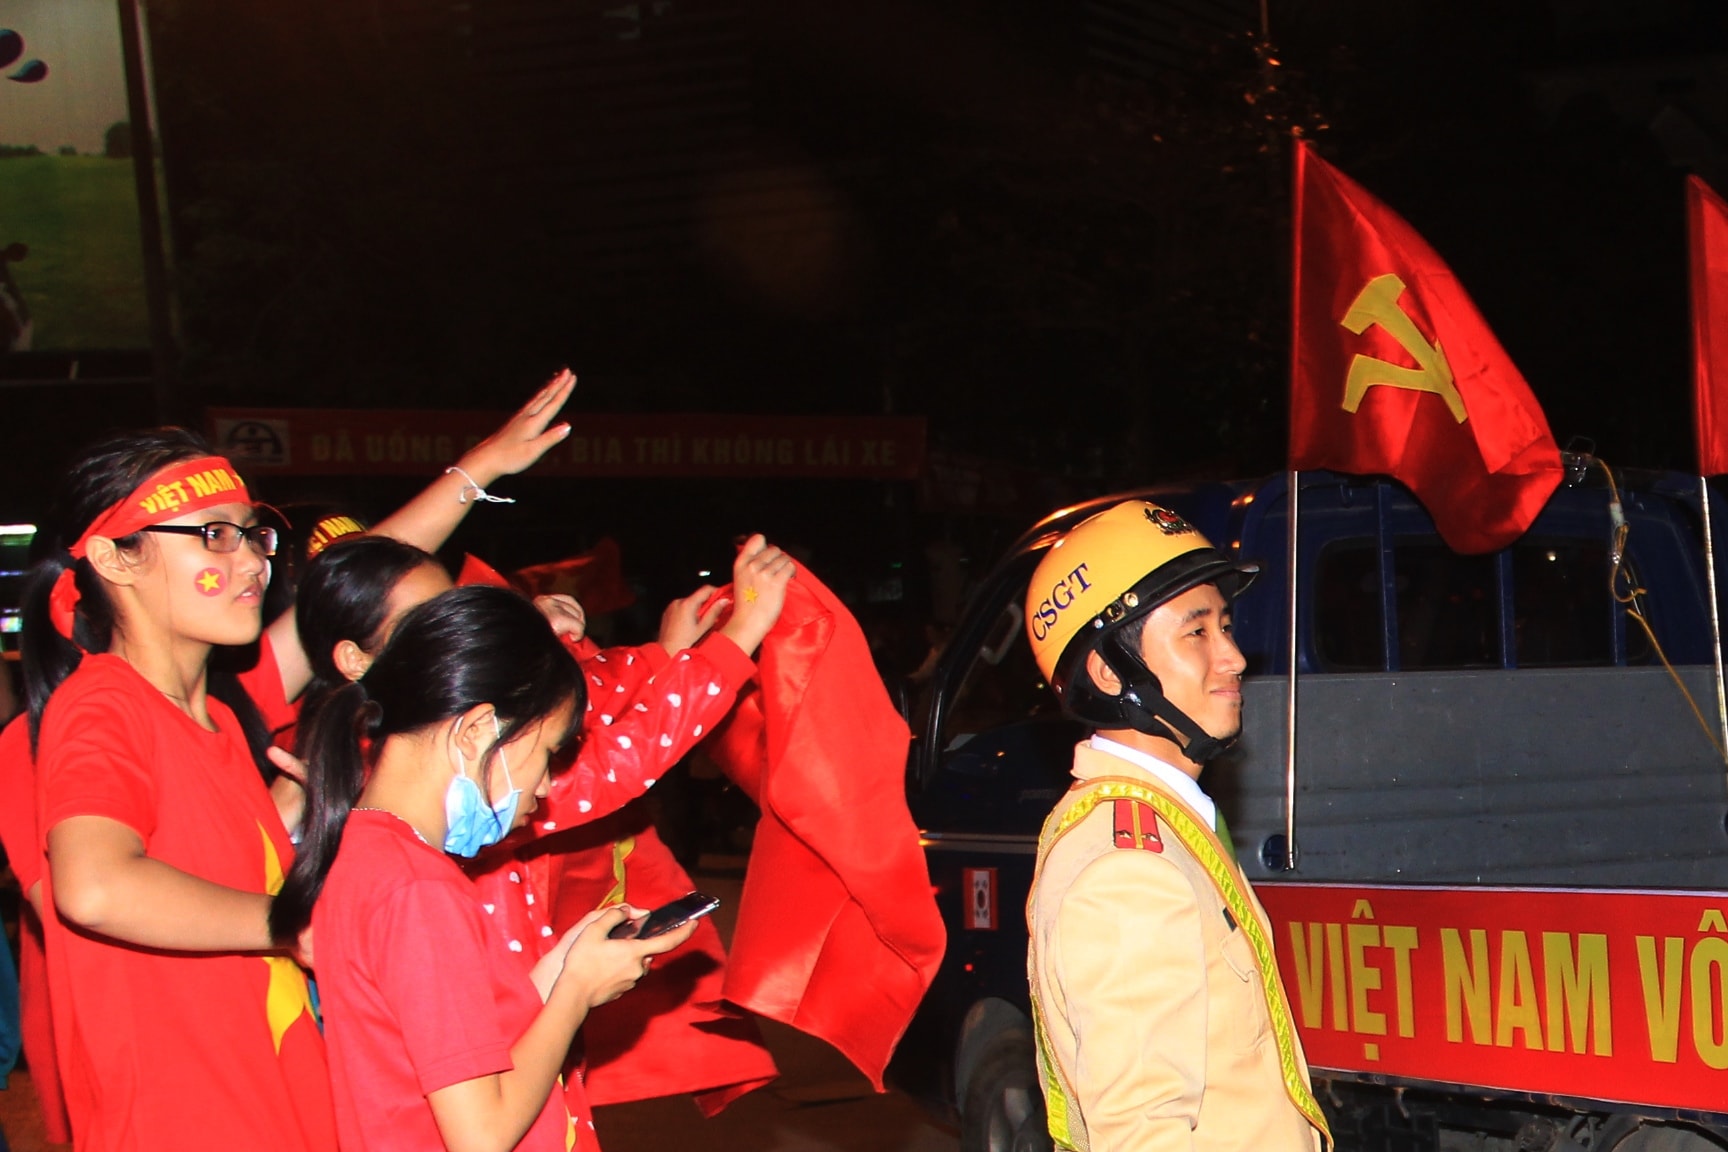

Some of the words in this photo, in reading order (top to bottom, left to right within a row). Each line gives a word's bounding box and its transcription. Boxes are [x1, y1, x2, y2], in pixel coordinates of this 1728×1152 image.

[311, 428, 354, 463] ĐÃ
[571, 435, 624, 464] BIA
[691, 432, 795, 465] KHÔNG
[861, 439, 898, 466] XE
[139, 481, 191, 514] VIỆT
[185, 468, 237, 498] NAM
[1032, 562, 1092, 642] CSGT
[1289, 899, 1419, 1062] VIỆT
[1440, 927, 1614, 1058] NAM
